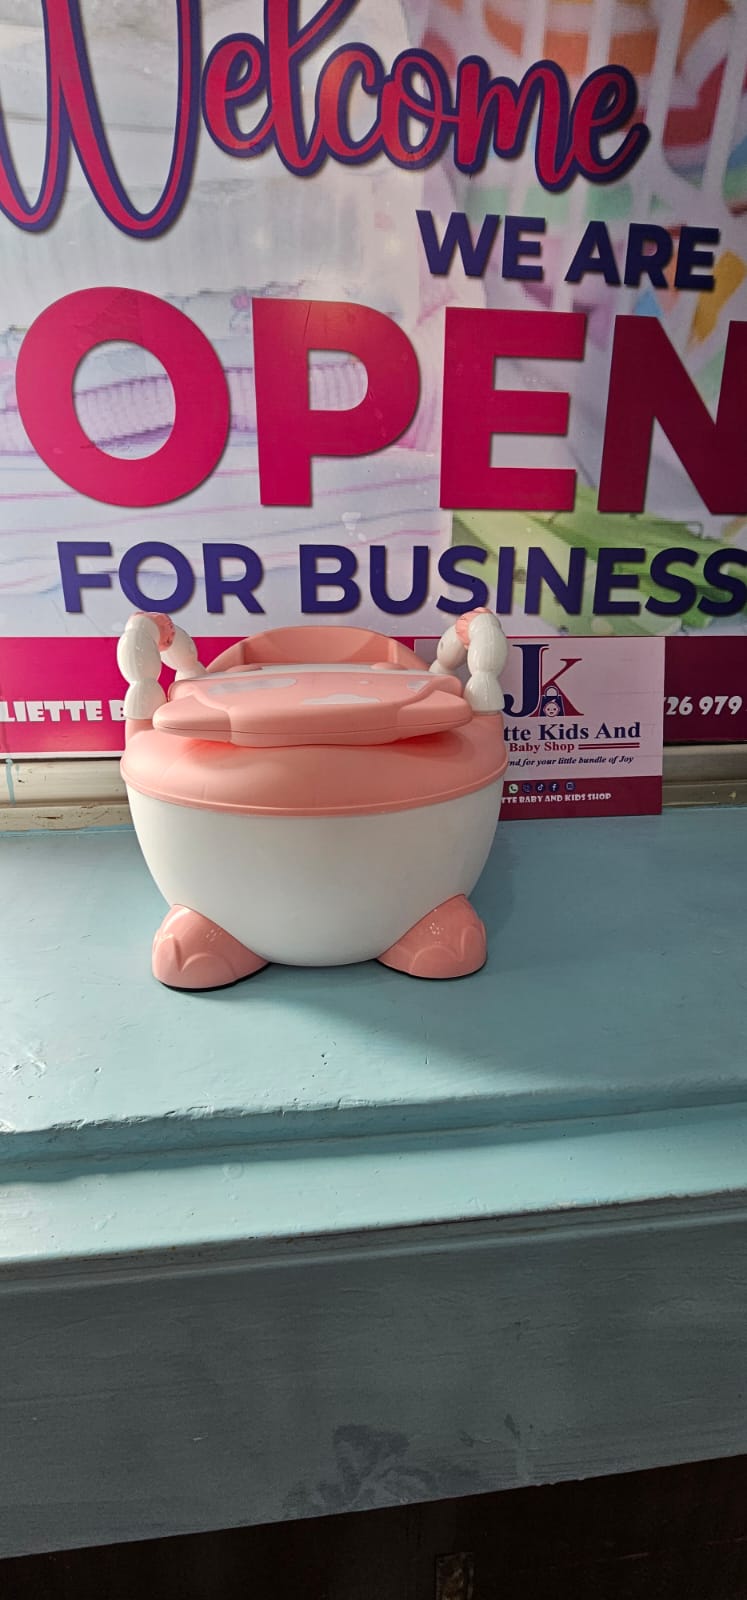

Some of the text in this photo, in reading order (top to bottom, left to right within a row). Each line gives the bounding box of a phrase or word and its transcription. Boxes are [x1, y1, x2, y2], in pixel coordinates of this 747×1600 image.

[0, 0, 649, 238] Welcome
[415, 209, 720, 290] WE ARE
[15, 286, 747, 515] OPEN
[56, 540, 747, 616] FOR BUSINESS
[664, 695, 743, 716] 26 979
[537, 723, 589, 741] Kids
[594, 721, 641, 739] And
[509, 741, 575, 753] Baby Shop
[536, 758, 557, 767] your
[557, 756, 577, 765] little
[578, 755, 607, 764] bundle
[608, 755, 619, 765] of
[618, 755, 634, 764] Joy
[519, 795, 543, 803] BABY
[545, 794, 563, 802] AND
[564, 793, 586, 801] KIDS
[587, 792, 612, 801] SHOP
